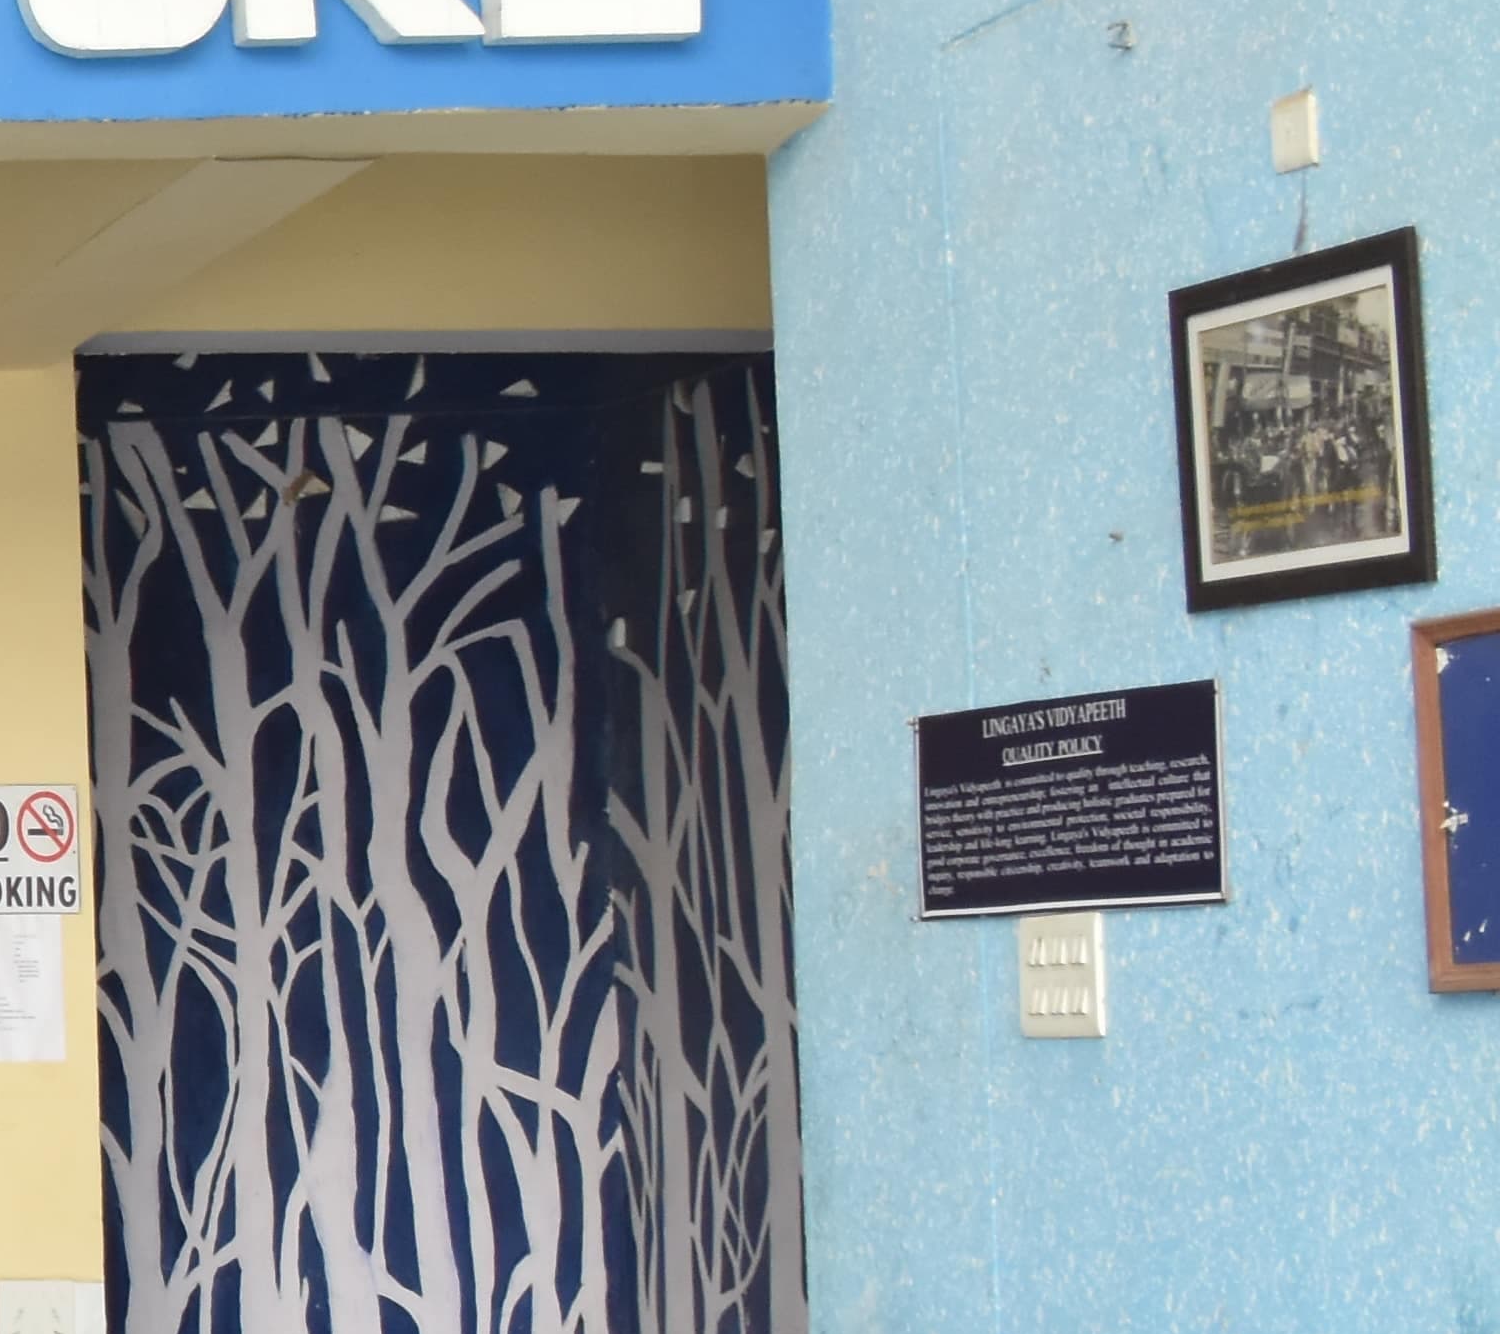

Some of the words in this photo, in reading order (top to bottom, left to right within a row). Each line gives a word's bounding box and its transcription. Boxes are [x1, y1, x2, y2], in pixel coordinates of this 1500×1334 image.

[1046, 698, 1126, 728] VIDYAPEETH
[1002, 741, 1053, 764] QUALITY
[1058, 735, 1103, 756] POLICY
